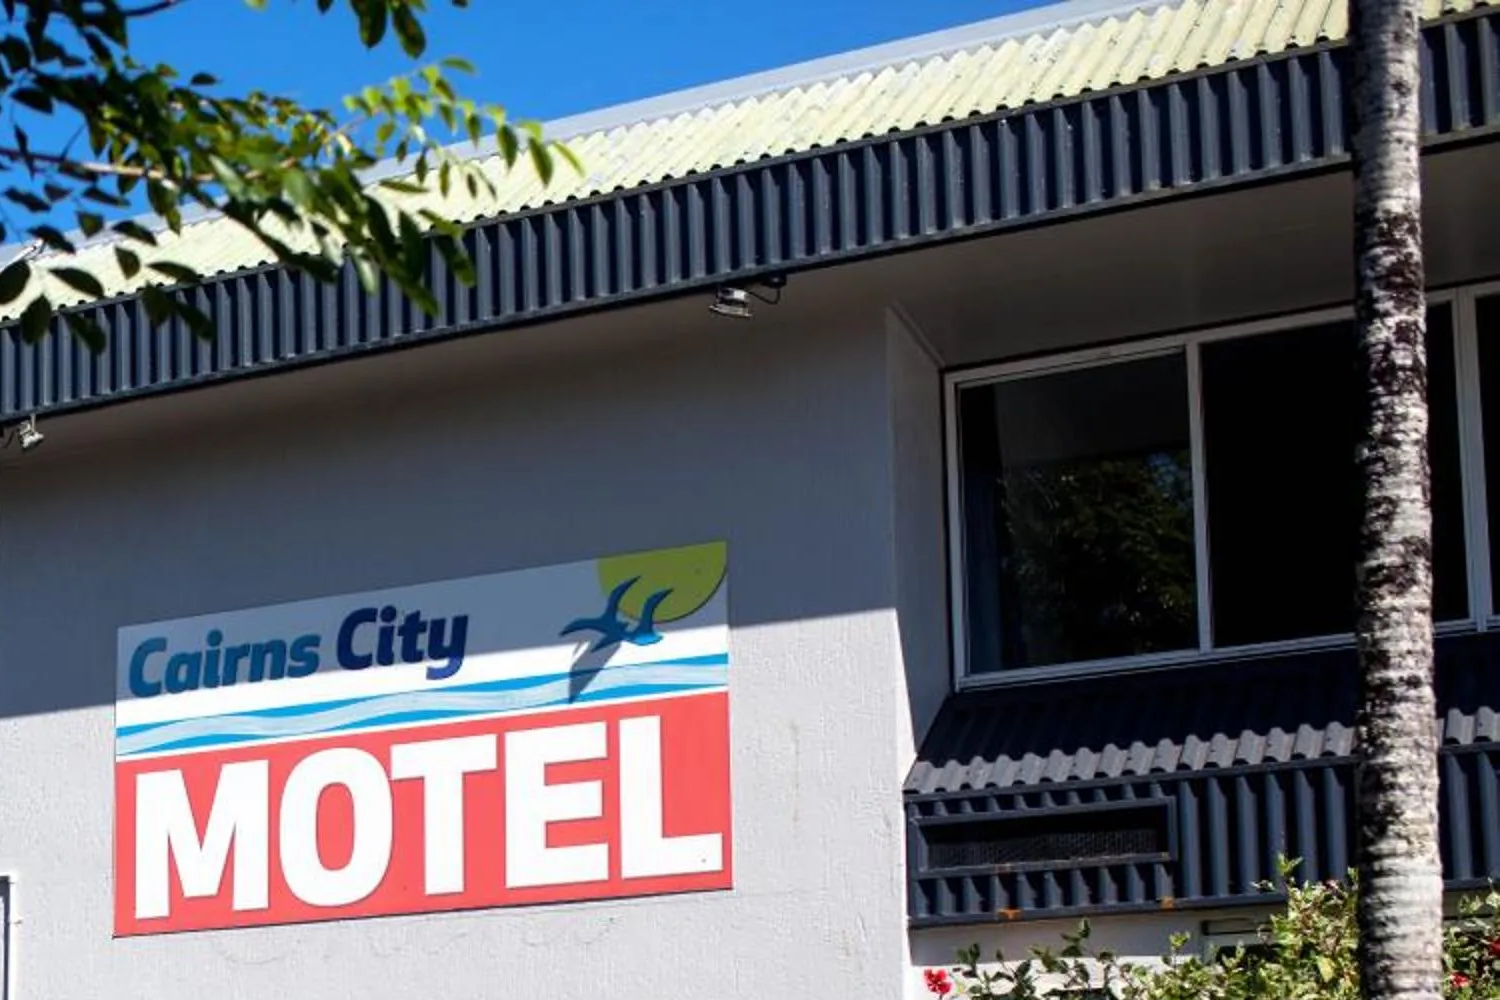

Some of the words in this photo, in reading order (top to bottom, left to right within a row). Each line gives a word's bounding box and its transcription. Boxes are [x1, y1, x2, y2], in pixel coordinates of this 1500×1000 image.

[128, 627, 321, 699] Cairns
[336, 605, 470, 681] City
[134, 715, 723, 920] MOTEL
